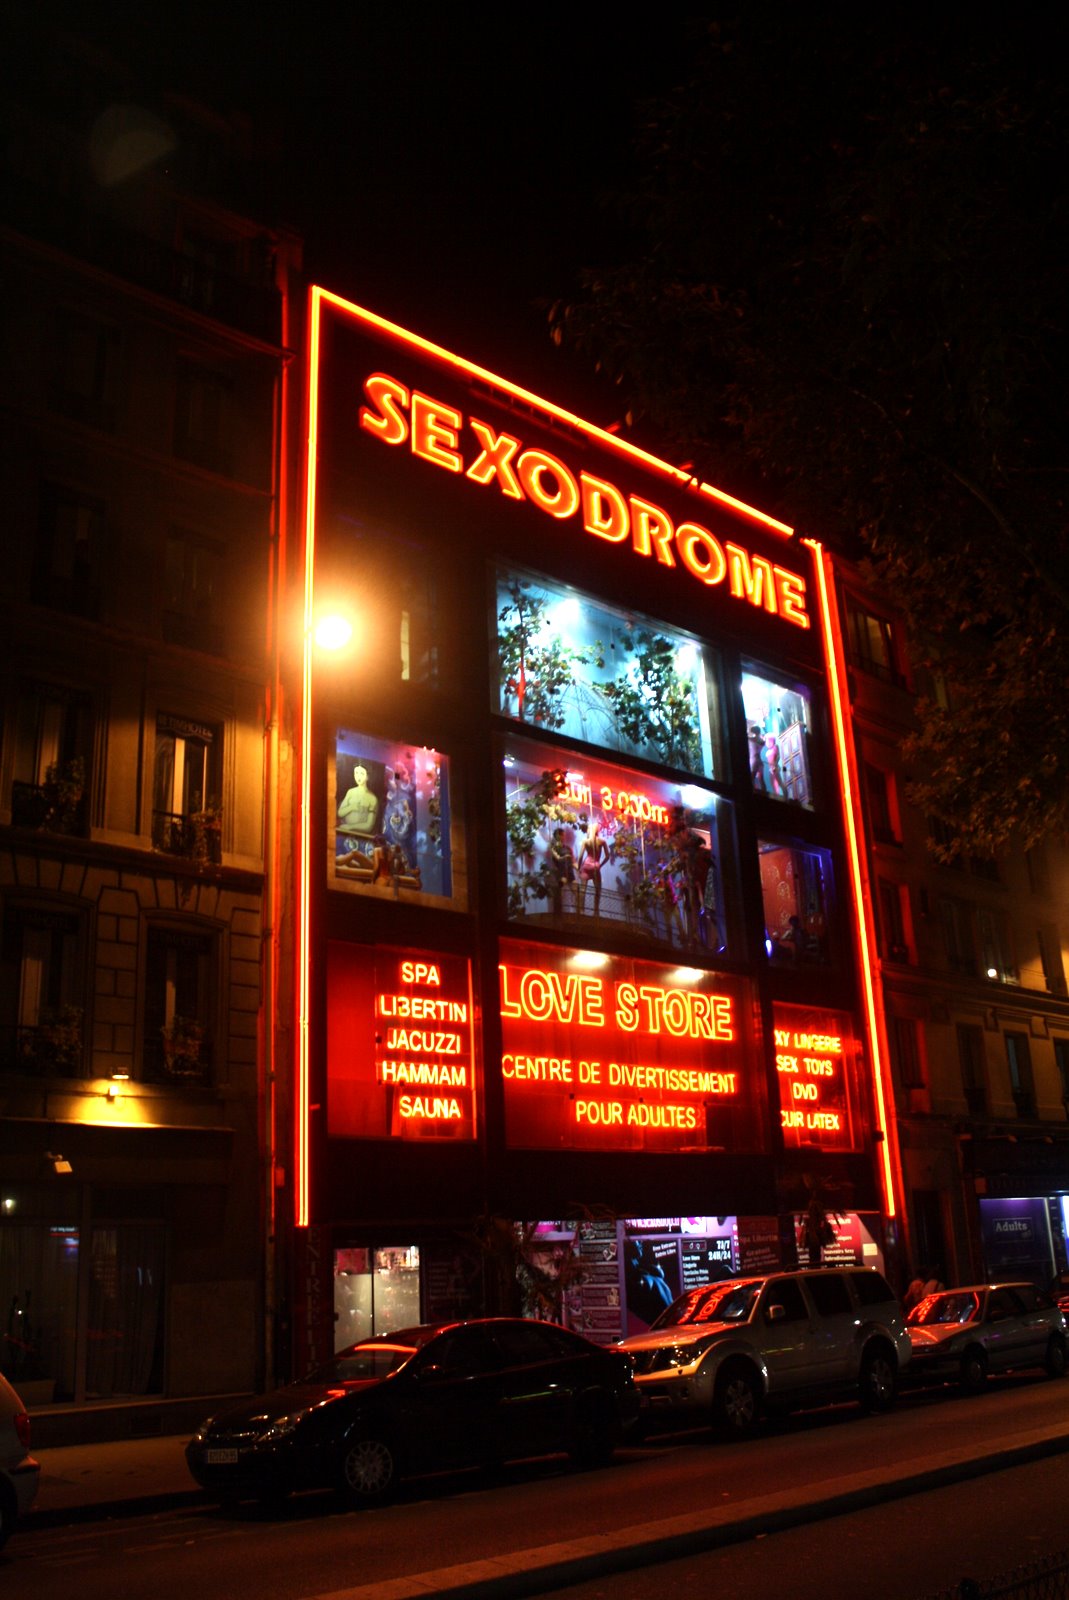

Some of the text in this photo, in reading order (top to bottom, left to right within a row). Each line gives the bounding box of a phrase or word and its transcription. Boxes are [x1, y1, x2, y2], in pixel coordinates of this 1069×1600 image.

[359, 371, 811, 630] SEXODROME
[600, 786, 614, 811] 3
[402, 961, 440, 986] SPA
[499, 966, 733, 1041] LOVE STORE
[387, 1028, 461, 1054] JACUZZI
[794, 1033, 841, 1053] LINGERIE
[382, 1060, 466, 1087] HAMMAM
[502, 1054, 735, 1094] CENTRE DE DIVERTISSEMENT
[776, 1054, 833, 1076] SEX TOYS
[793, 1082, 818, 1101] DVD
[400, 1096, 461, 1120] SAUNA
[575, 1101, 697, 1129] POUR ADULTES
[807, 1112, 840, 1131] LATEX
[995, 1221, 1028, 1233] Adults
[708, 1250, 731, 1262] 24H/24
